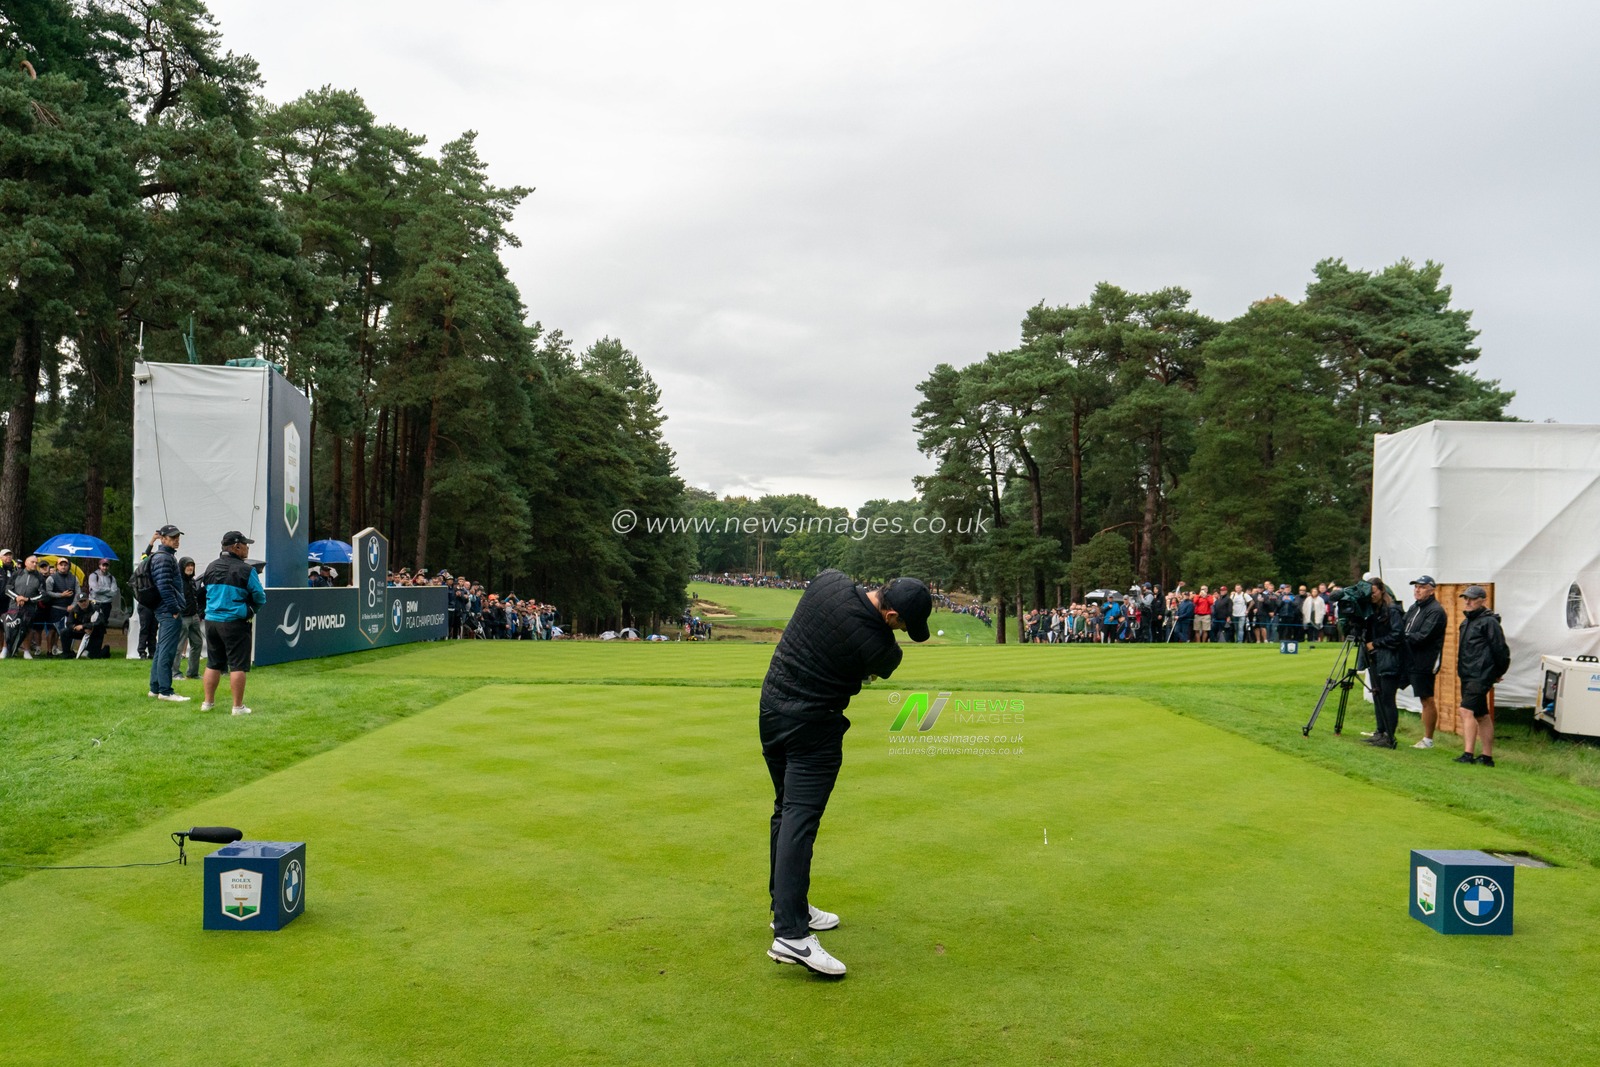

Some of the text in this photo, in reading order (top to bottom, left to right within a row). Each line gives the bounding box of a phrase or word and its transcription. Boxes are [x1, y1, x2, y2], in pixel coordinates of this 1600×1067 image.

[368, 577, 376, 608] 8
[406, 600, 419, 613] BMW
[305, 613, 346, 631] DP WORLD
[405, 613, 446, 629] PGA CHAMPIONSHIP
[1460, 878, 1498, 893] BMW
